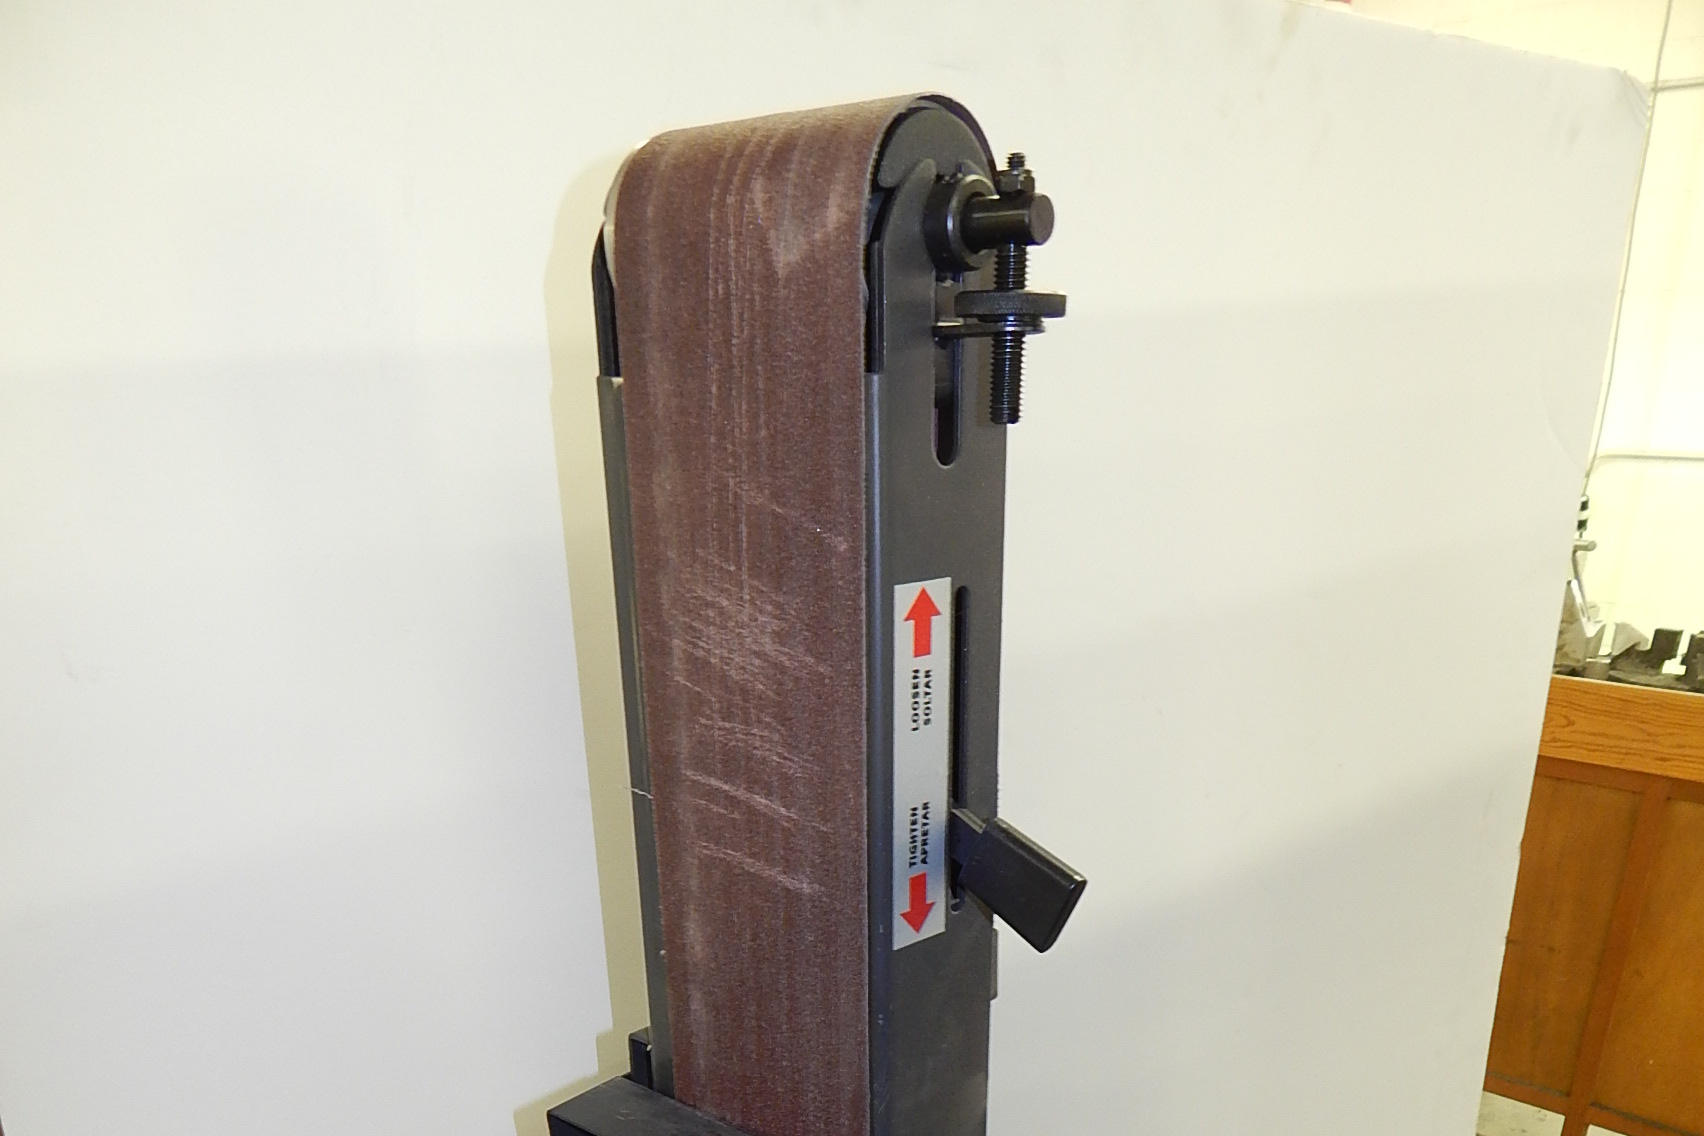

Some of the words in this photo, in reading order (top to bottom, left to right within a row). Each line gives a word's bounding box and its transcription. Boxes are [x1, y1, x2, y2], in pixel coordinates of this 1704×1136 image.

[911, 669, 920, 732] LOOSEN
[923, 669, 932, 727] SOLTAR
[909, 806, 919, 869] TIGHTEN
[920, 801, 930, 865] APRETAR
